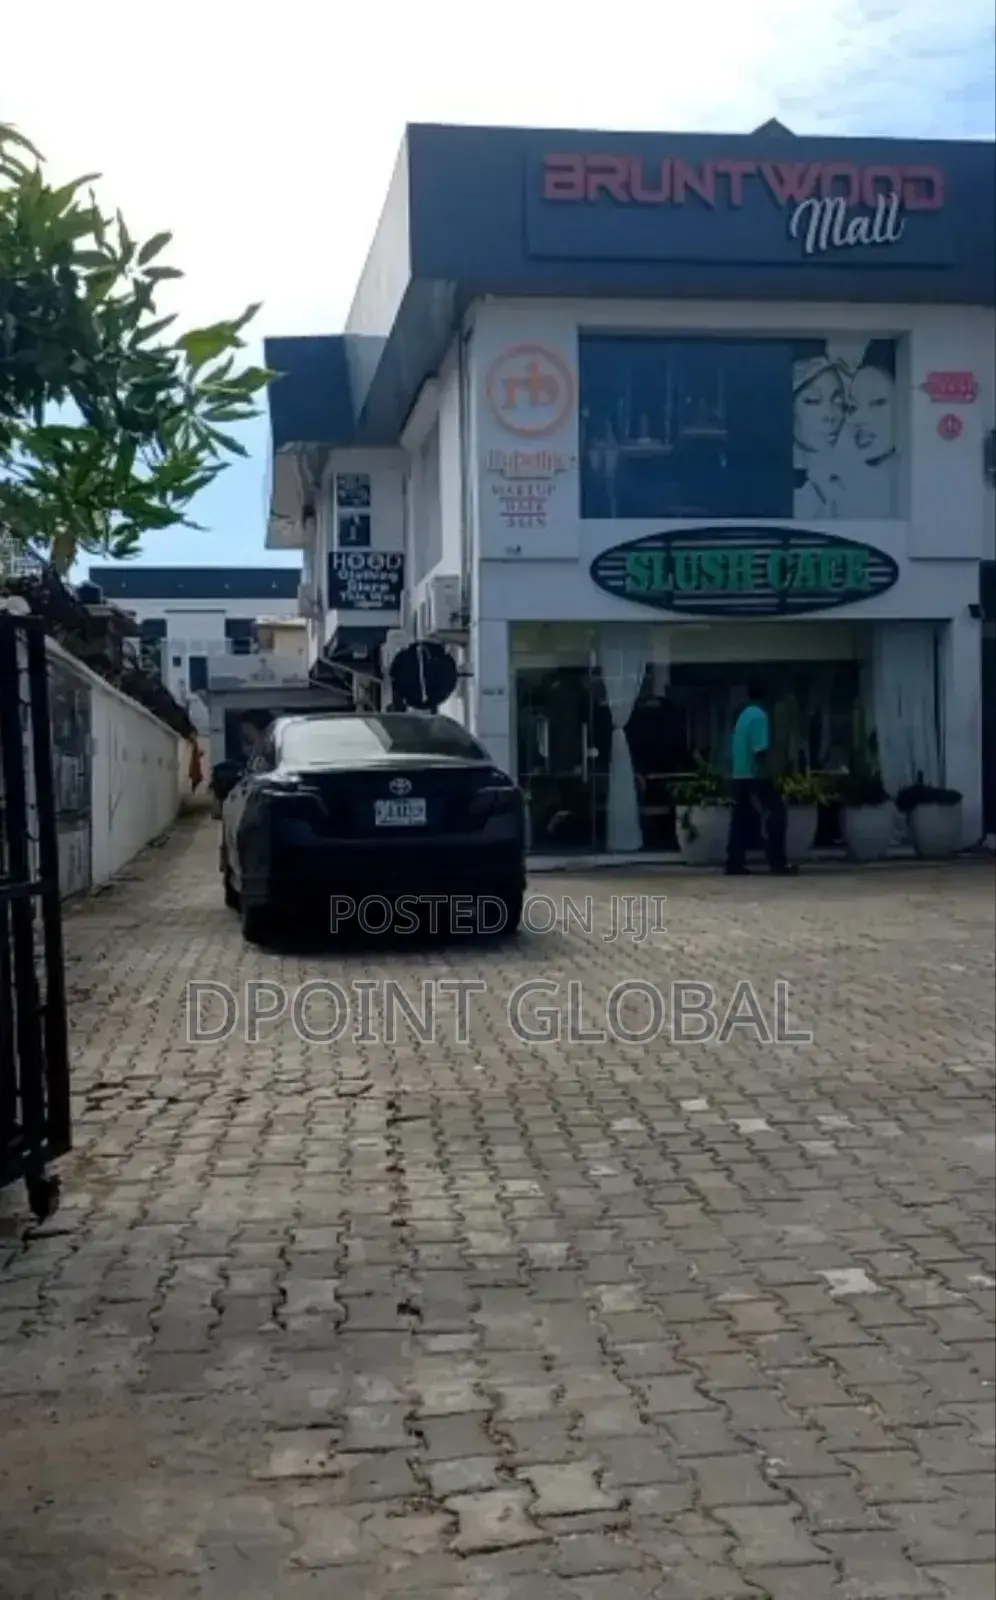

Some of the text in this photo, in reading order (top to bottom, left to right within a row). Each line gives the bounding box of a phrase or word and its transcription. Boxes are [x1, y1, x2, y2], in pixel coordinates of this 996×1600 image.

[542, 154, 946, 211] BRUNTWOOD
[790, 192, 903, 254] Mall
[333, 552, 402, 569] HOOD
[625, 550, 752, 593] SLUSH
